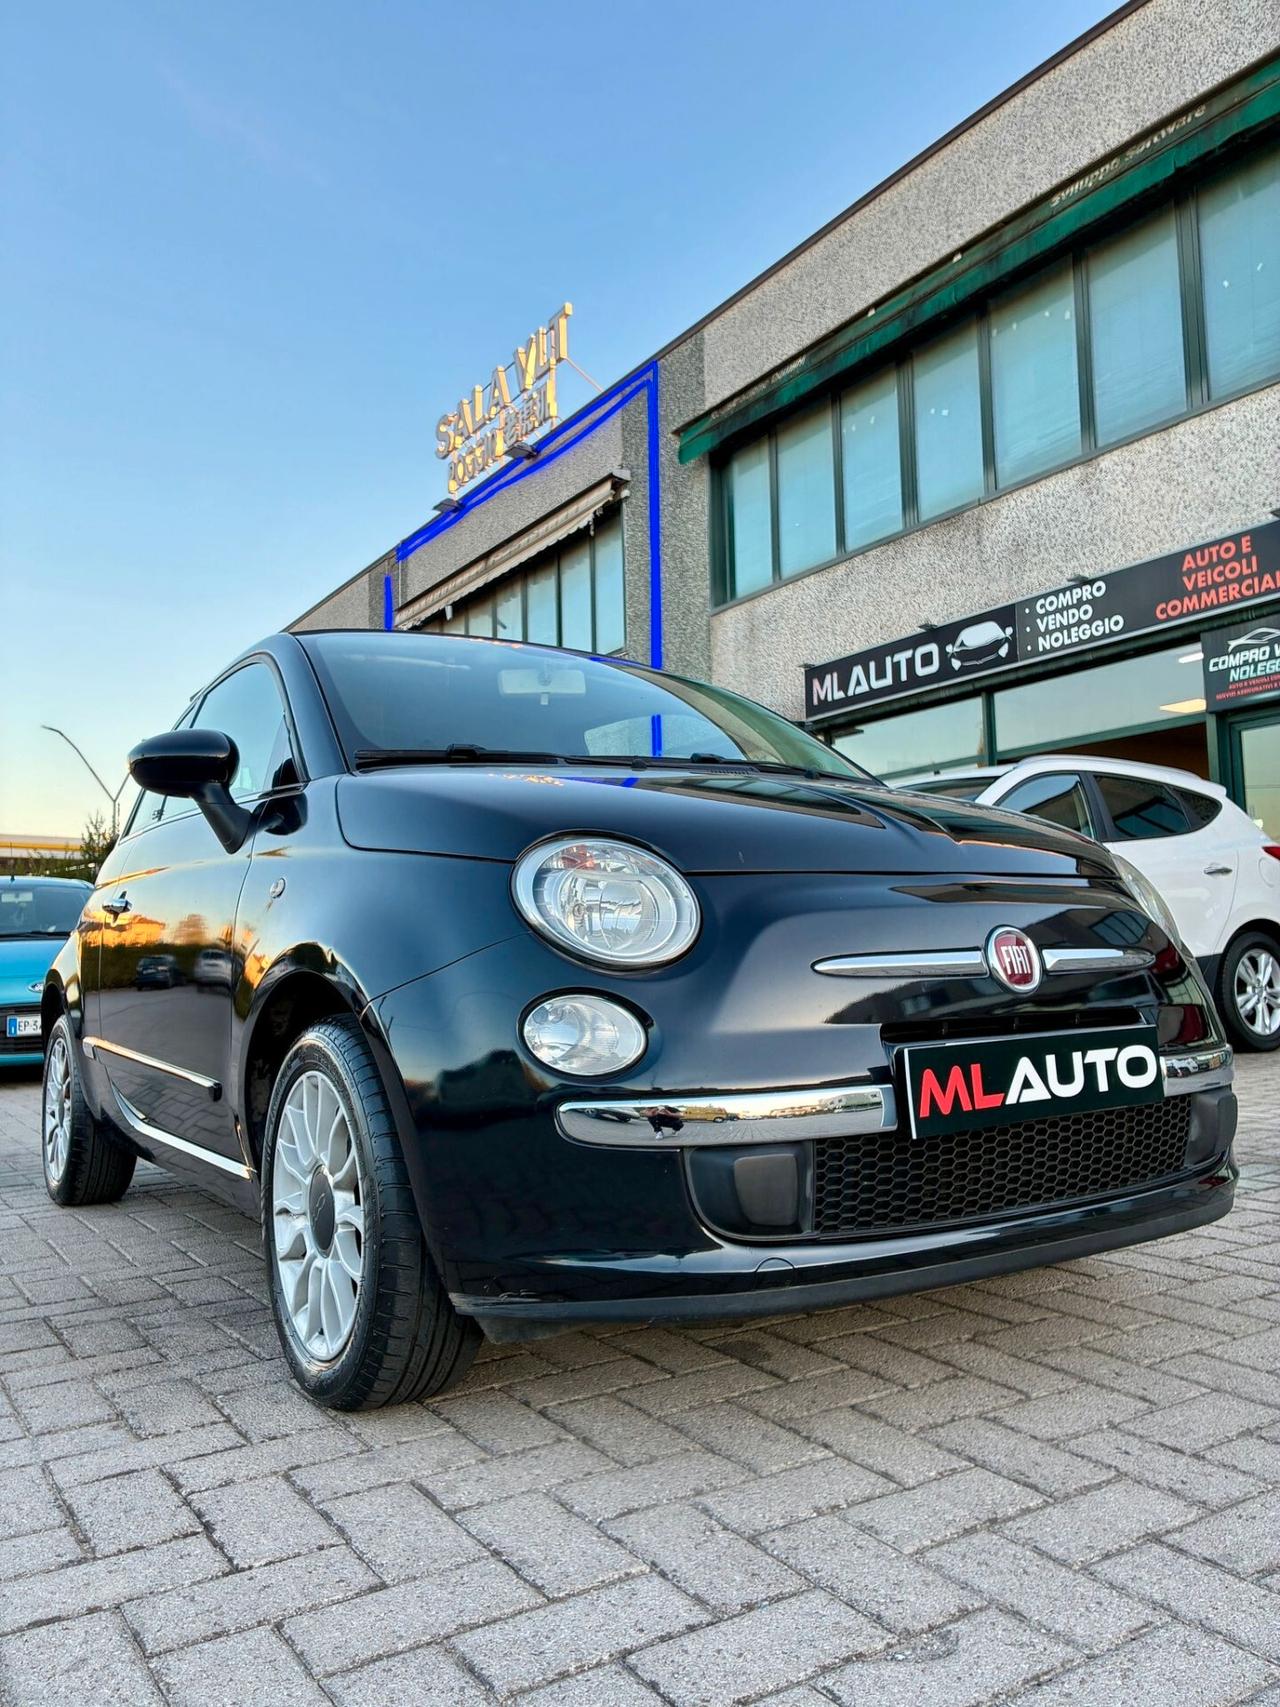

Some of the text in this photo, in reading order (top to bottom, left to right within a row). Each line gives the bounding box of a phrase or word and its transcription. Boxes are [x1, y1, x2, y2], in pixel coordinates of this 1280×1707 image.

[436, 365, 512, 459] SALA
[1181, 535, 1252, 571] AUTO E
[1183, 555, 1257, 591] VEICOLI
[1036, 580, 1106, 615] COMPRO
[1036, 604, 1093, 633] VENDO
[1038, 614, 1124, 652] NOLEGGIO
[812, 642, 940, 706] MLAUTO
[1208, 645, 1270, 672] COMPRO
[1001, 945, 1033, 975] FIAT
[919, 1044, 1158, 1118] MLAUTO
